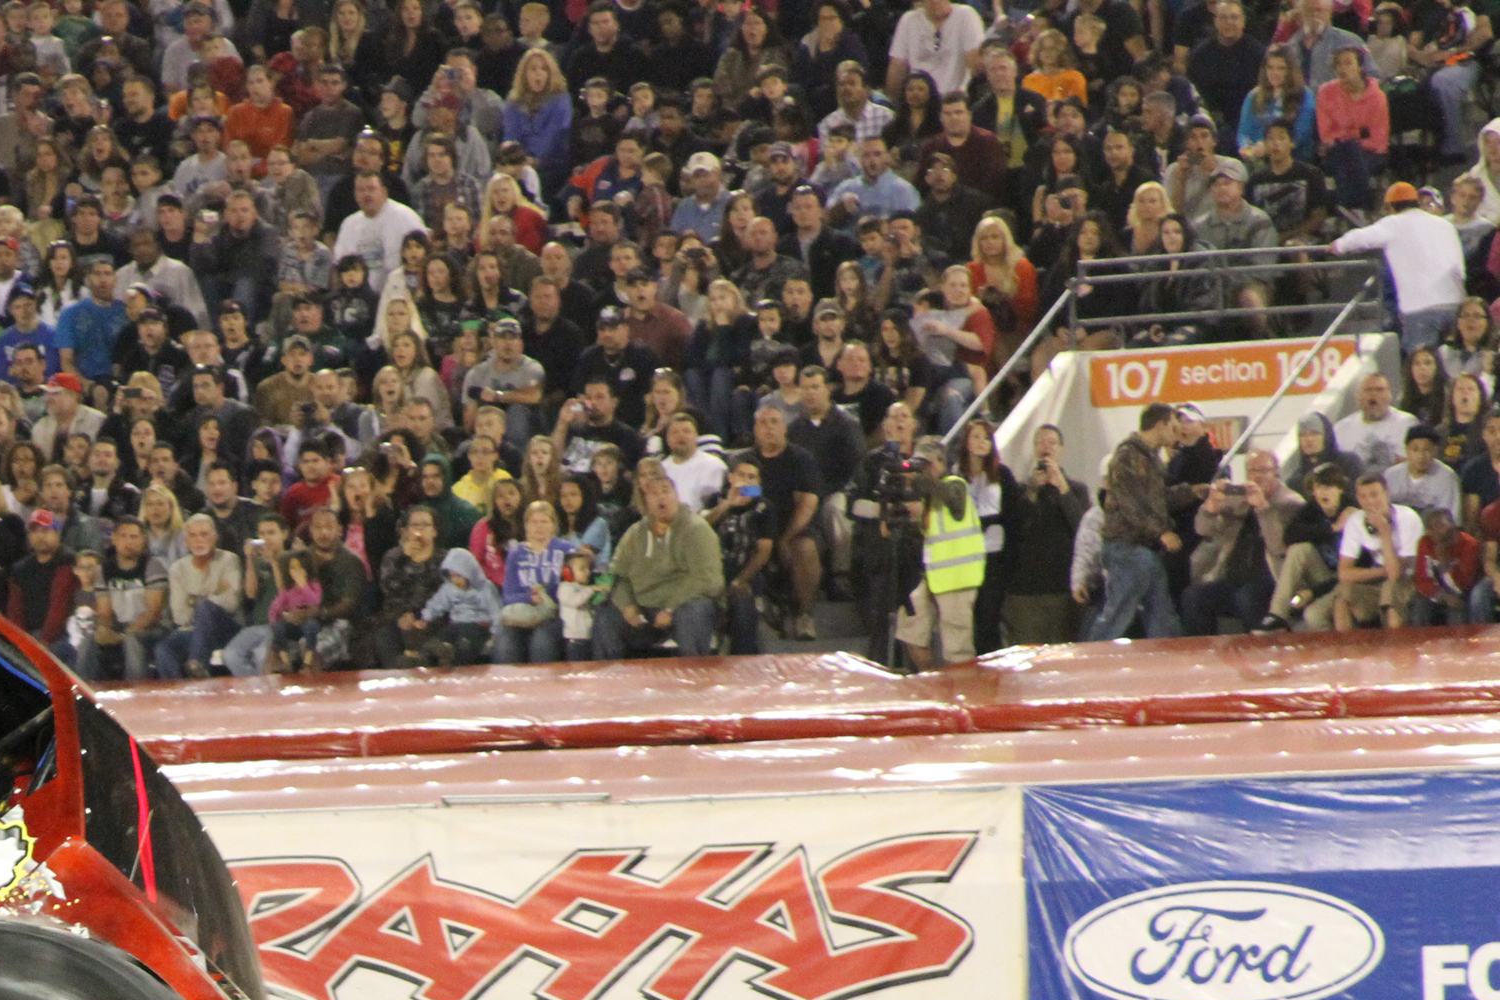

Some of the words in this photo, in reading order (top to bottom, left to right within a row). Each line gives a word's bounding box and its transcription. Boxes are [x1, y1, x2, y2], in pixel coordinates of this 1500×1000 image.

[1106, 359, 1169, 401] 107
[1180, 357, 1268, 386] section
[1276, 346, 1343, 389] 108
[1130, 904, 1315, 986] Ford
